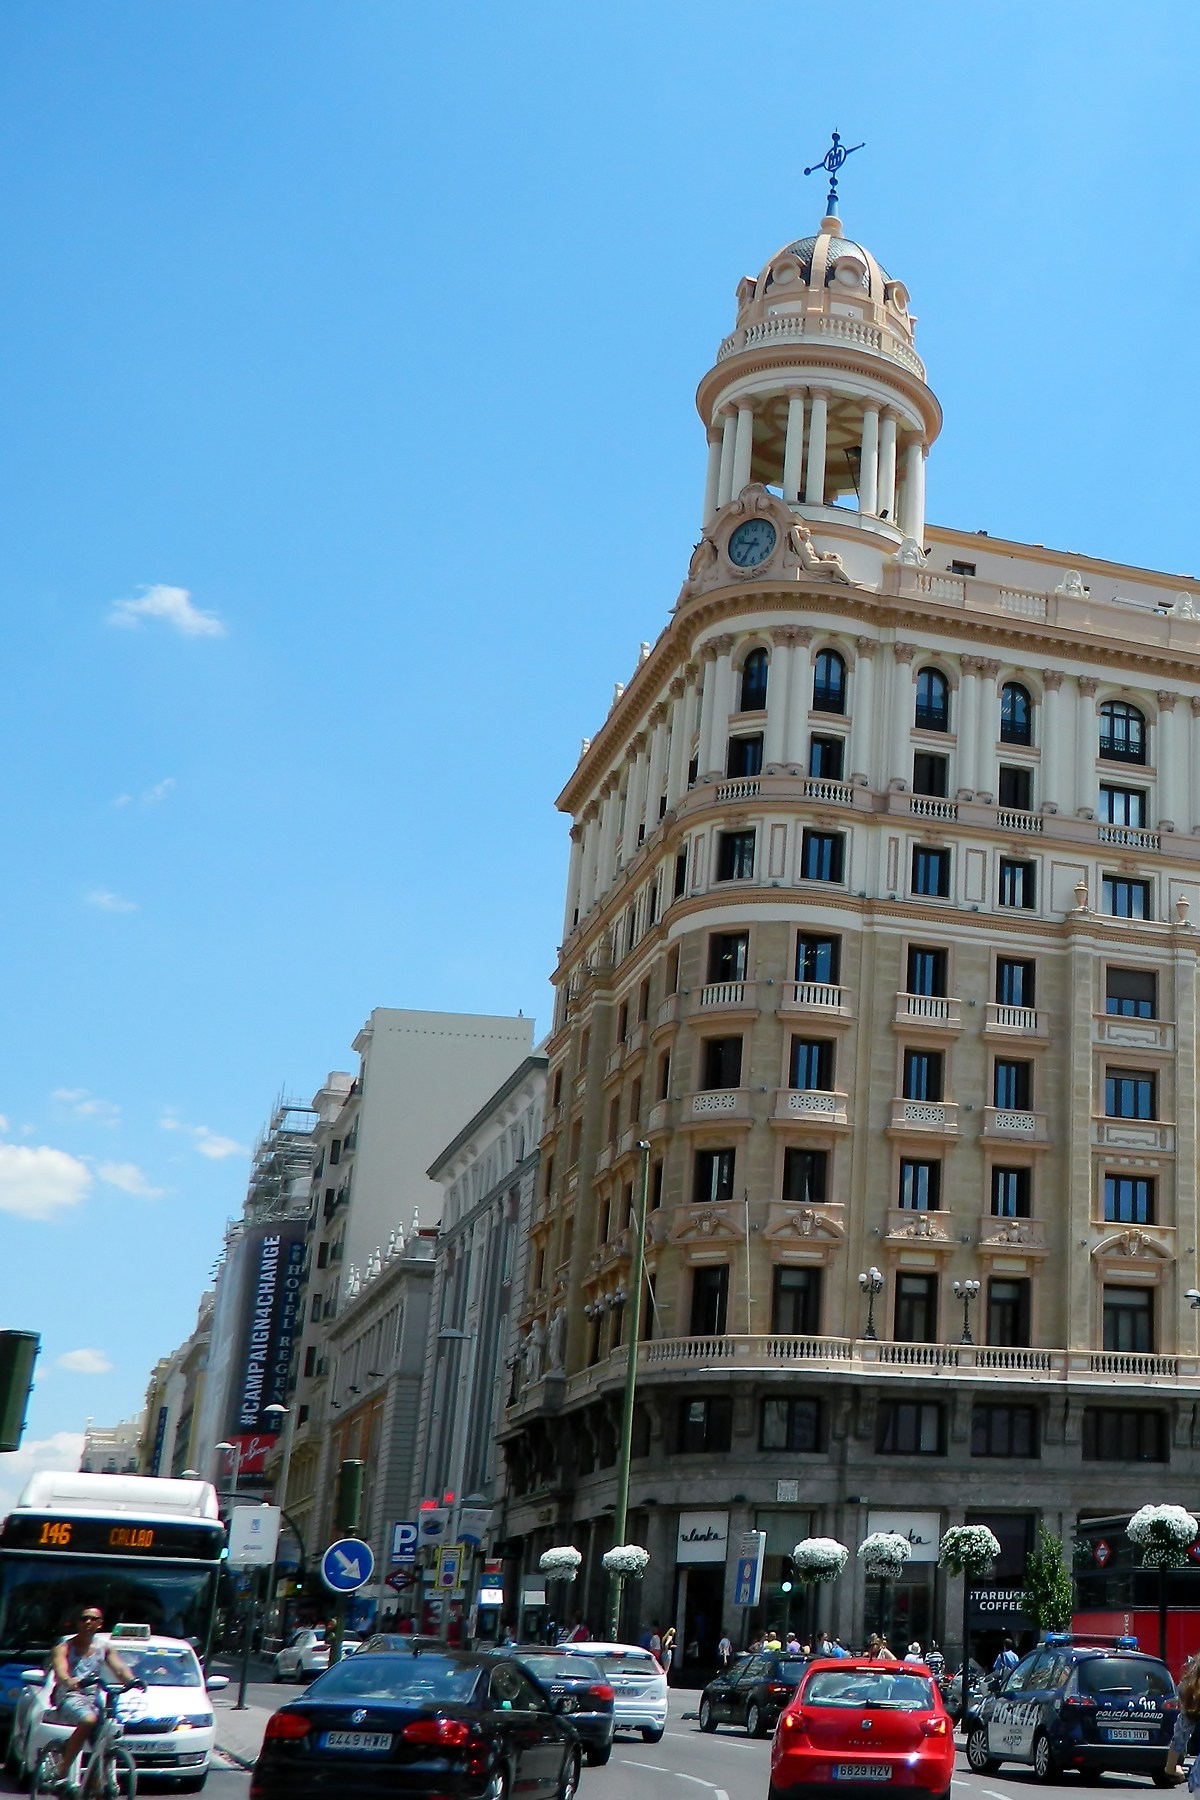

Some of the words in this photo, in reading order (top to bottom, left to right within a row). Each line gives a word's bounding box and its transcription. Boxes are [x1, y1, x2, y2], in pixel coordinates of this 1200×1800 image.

[282, 1264, 302, 1329] HOTEL
[241, 1234, 280, 1426] #CAMPAIGN4CHANGE
[270, 1336, 291, 1430] REGENE
[39, 1522, 73, 1545] 146
[110, 1528, 154, 1548] CALLAO
[393, 1524, 418, 1554] P
[979, 1601, 1023, 1612] COFFEE
[1095, 1710, 1129, 1718] POLICÍA
[1130, 1711, 1164, 1720] MADRID
[840, 1765, 868, 1776] 6829
[869, 1765, 890, 1776] HZV
